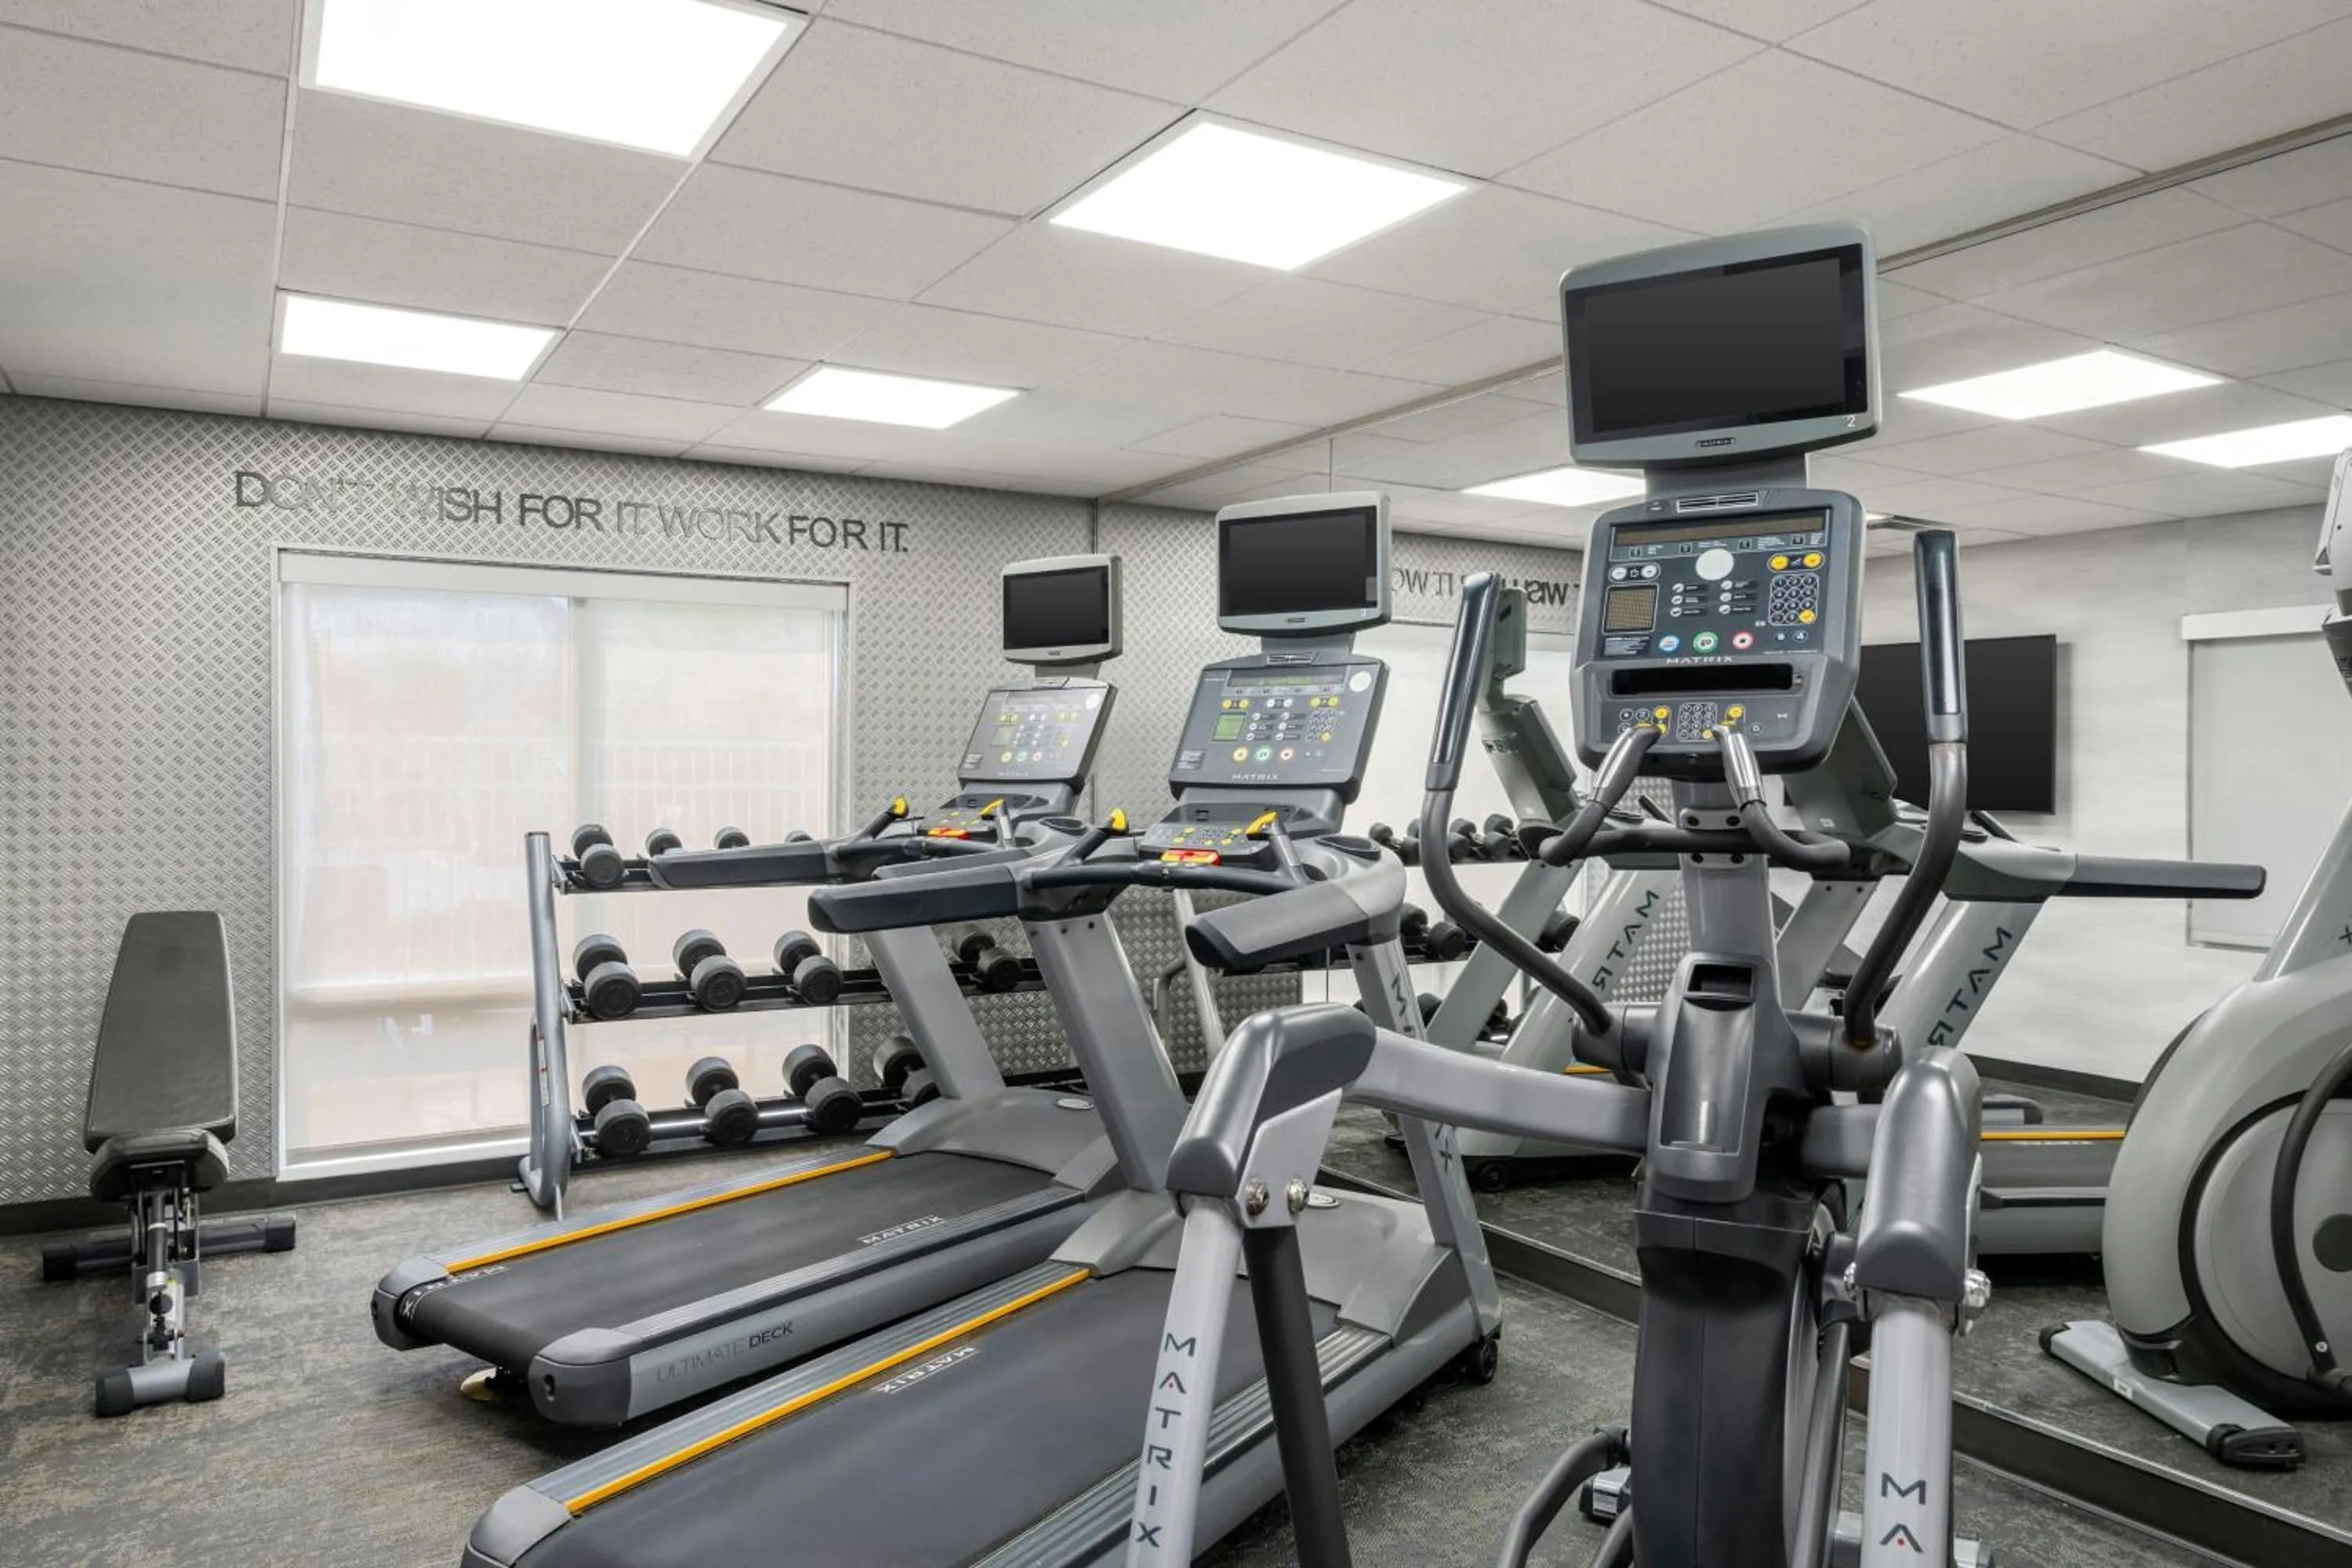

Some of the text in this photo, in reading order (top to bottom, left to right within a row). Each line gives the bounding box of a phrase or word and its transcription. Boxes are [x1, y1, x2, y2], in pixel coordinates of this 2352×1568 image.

[1846, 415, 1857, 428] 2
[520, 494, 604, 532] FOR
[658, 504, 781, 544] WORK
[789, 515, 868, 550] FOR
[879, 521, 909, 553] IT.
[656, 1320, 794, 1383] ULTIMATE DECK
[1137, 1333, 1196, 1548] MATRIX
